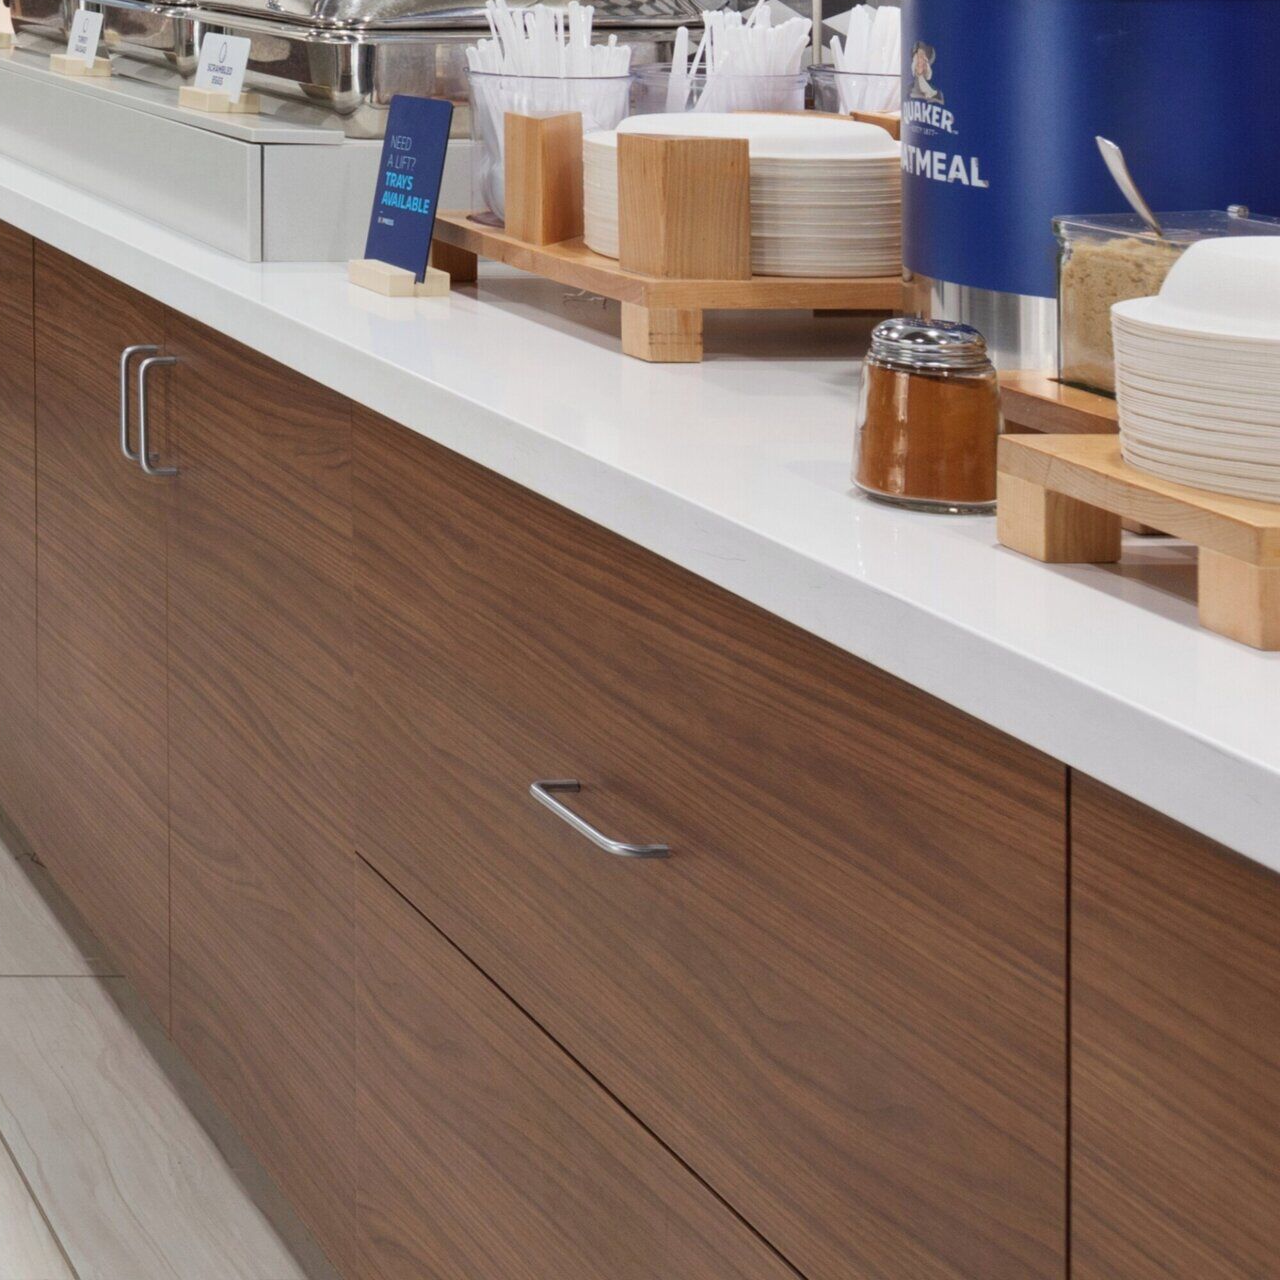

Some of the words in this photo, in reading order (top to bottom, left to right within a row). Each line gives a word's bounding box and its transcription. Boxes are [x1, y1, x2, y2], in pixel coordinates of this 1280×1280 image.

[903, 100, 955, 133] QUAKER
[390, 135, 413, 151] NEED
[386, 154, 394, 167] A
[394, 155, 416, 171] LIFT?
[901, 143, 989, 188] ATMEAL
[385, 171, 414, 191] TRAYS
[381, 191, 431, 214] AVAILABLE
